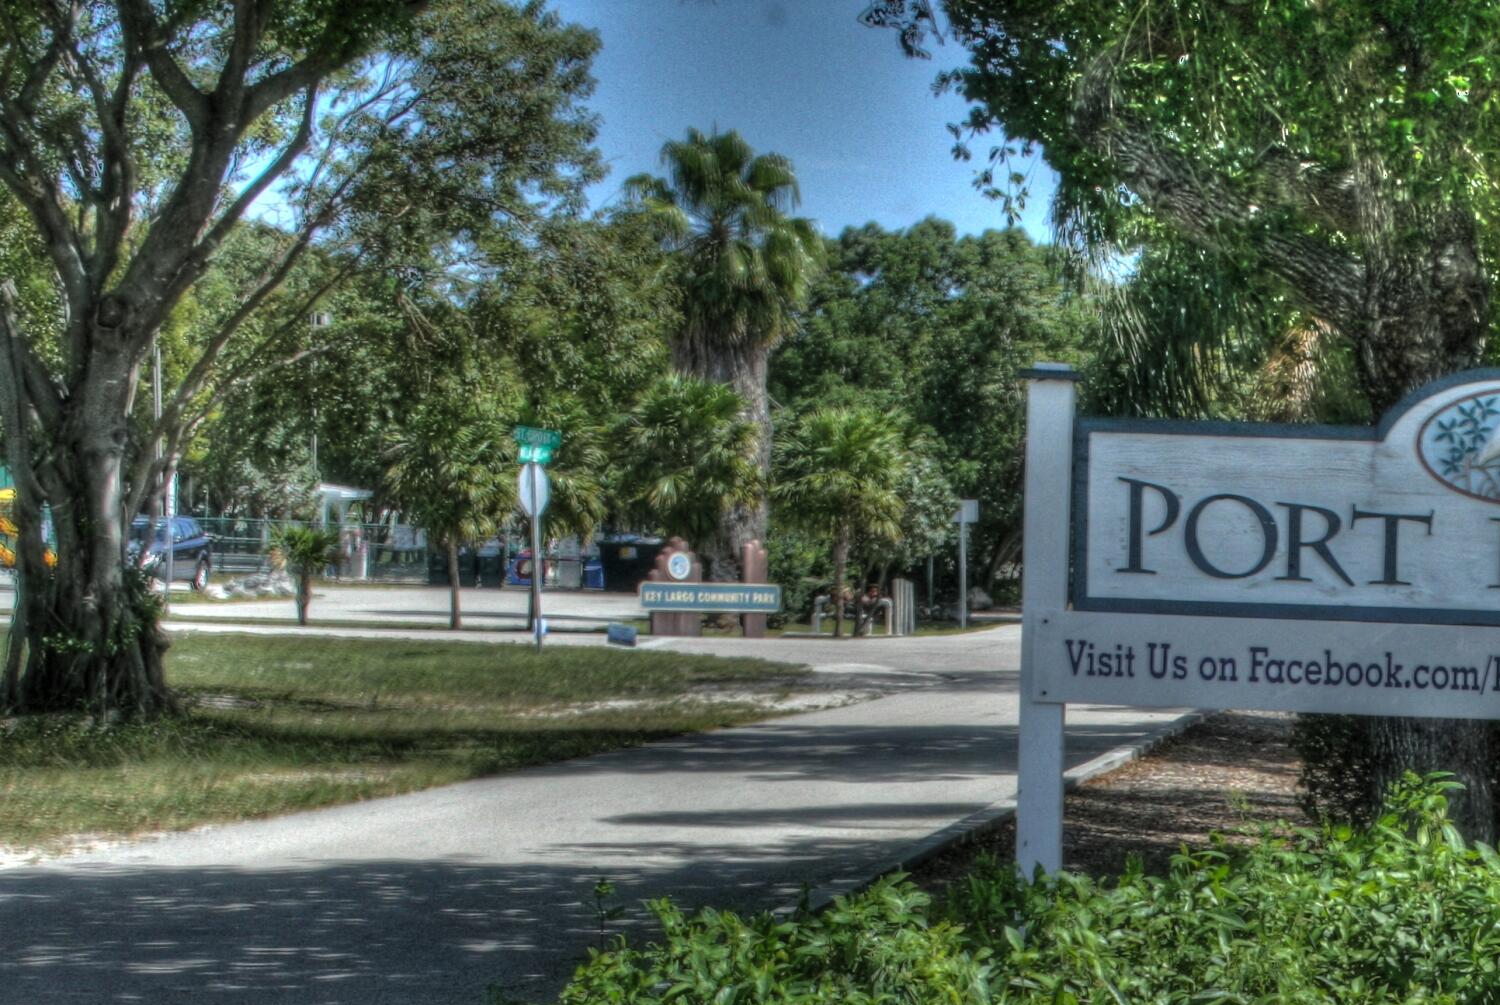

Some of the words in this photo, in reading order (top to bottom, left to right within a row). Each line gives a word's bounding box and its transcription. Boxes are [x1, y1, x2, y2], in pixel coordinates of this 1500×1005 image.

[1114, 476, 1435, 587] PORT
[645, 590, 662, 602] KEY
[665, 590, 695, 603] LARGO
[698, 591, 750, 604] COMMUNITY
[752, 592, 775, 604] PARK
[1065, 639, 1136, 678] Visit
[1146, 642, 1188, 680] Us
[1199, 654, 1238, 682] on
